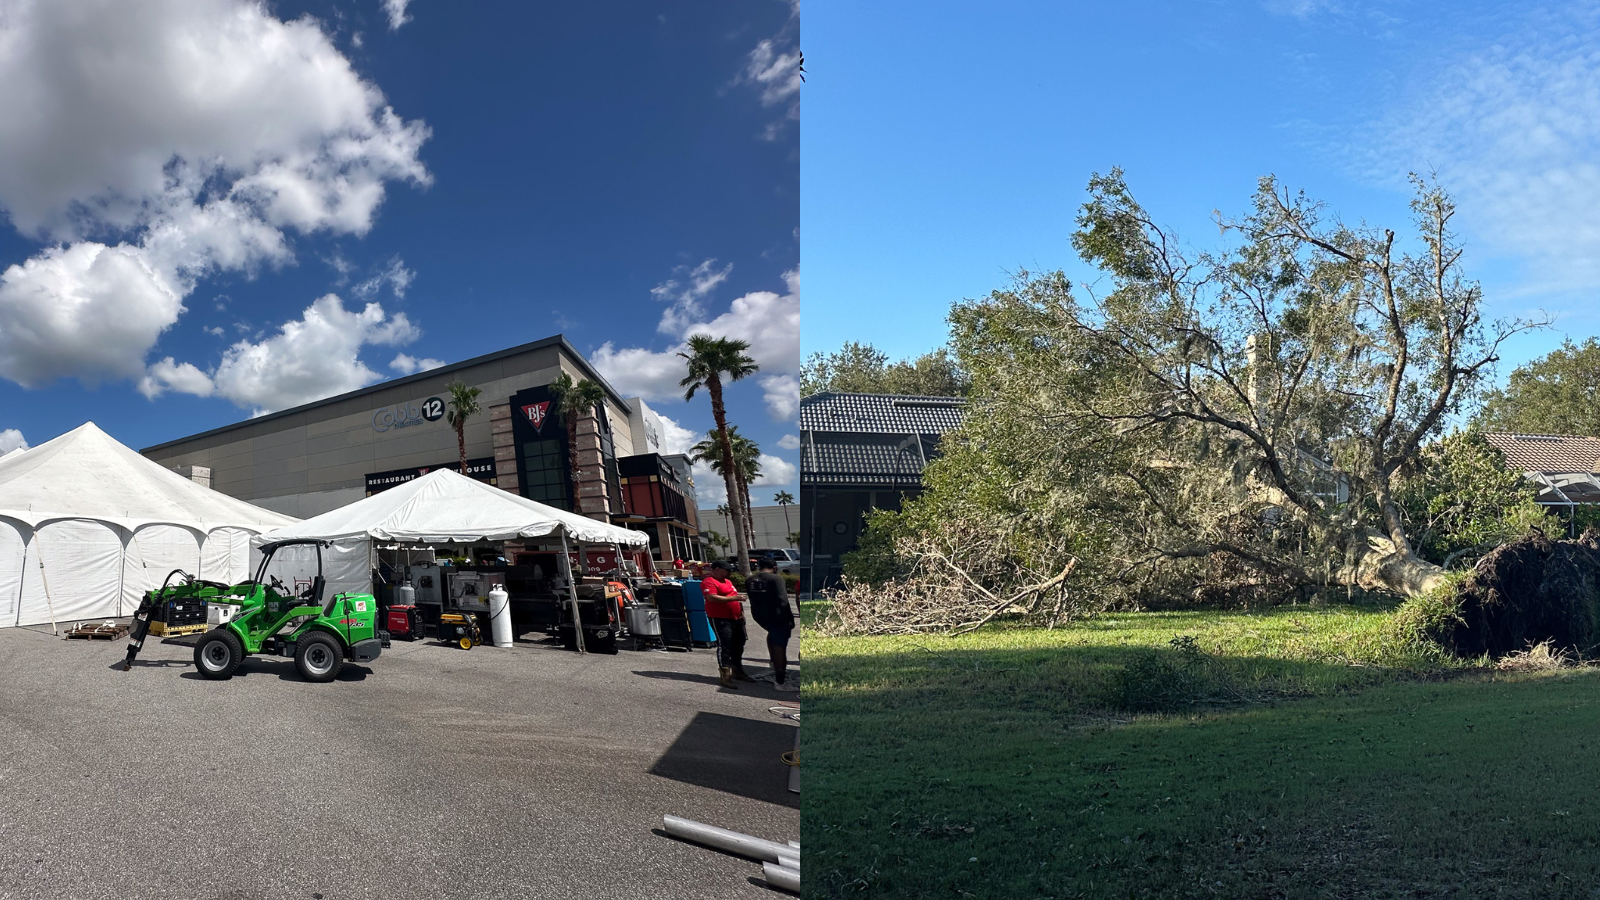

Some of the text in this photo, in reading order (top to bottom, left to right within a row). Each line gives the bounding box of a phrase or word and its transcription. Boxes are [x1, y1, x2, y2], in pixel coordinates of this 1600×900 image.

[372, 400, 442, 432] Cobb 12
[528, 404, 546, 423] BJ's
[368, 474, 415, 485] RESTAURANT
